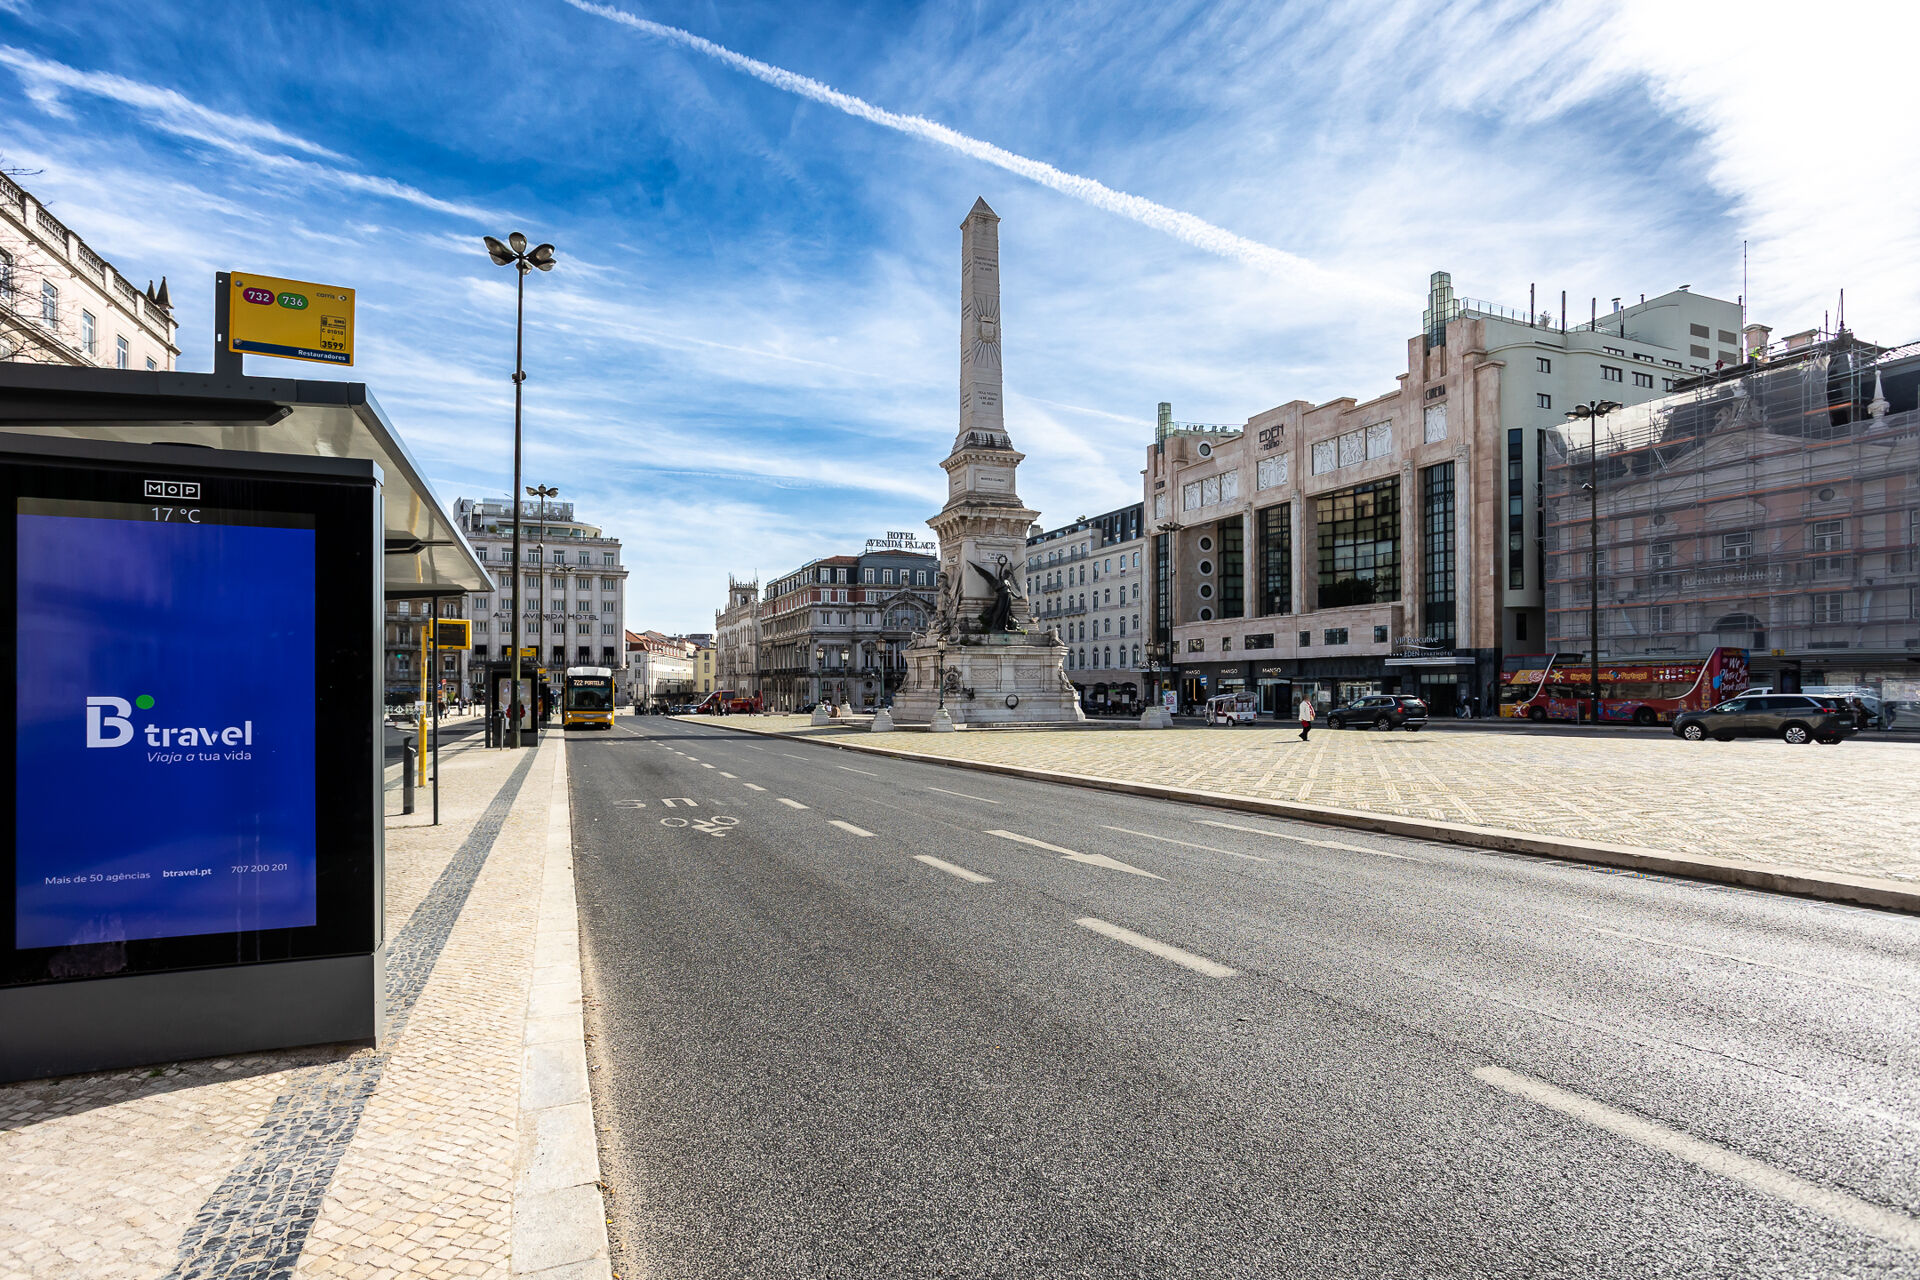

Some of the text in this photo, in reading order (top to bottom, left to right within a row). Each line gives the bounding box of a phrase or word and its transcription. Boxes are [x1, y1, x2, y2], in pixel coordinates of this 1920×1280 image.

[248, 290, 270, 303] 732
[282, 295, 303, 307] 736
[321, 340, 344, 350] 3599
[298, 349, 346, 361] Restauradores
[1259, 423, 1284, 443] EDEN
[146, 482, 198, 497] MOP
[151, 507, 201, 524] 17 °C
[887, 531, 916, 540] HOTEL
[865, 539, 936, 550] AVENIDA PALACE
[522, 612, 565, 620] AVENIDA
[1394, 636, 1439, 644] VIP Executive
[86, 696, 252, 749] B travel
[147, 750, 252, 764] Viaja a tua vida
[162, 868, 212, 878] btravel.pt
[231, 863, 288, 874] 707 200 201
[45, 871, 151, 885] Mais de 50 agências
